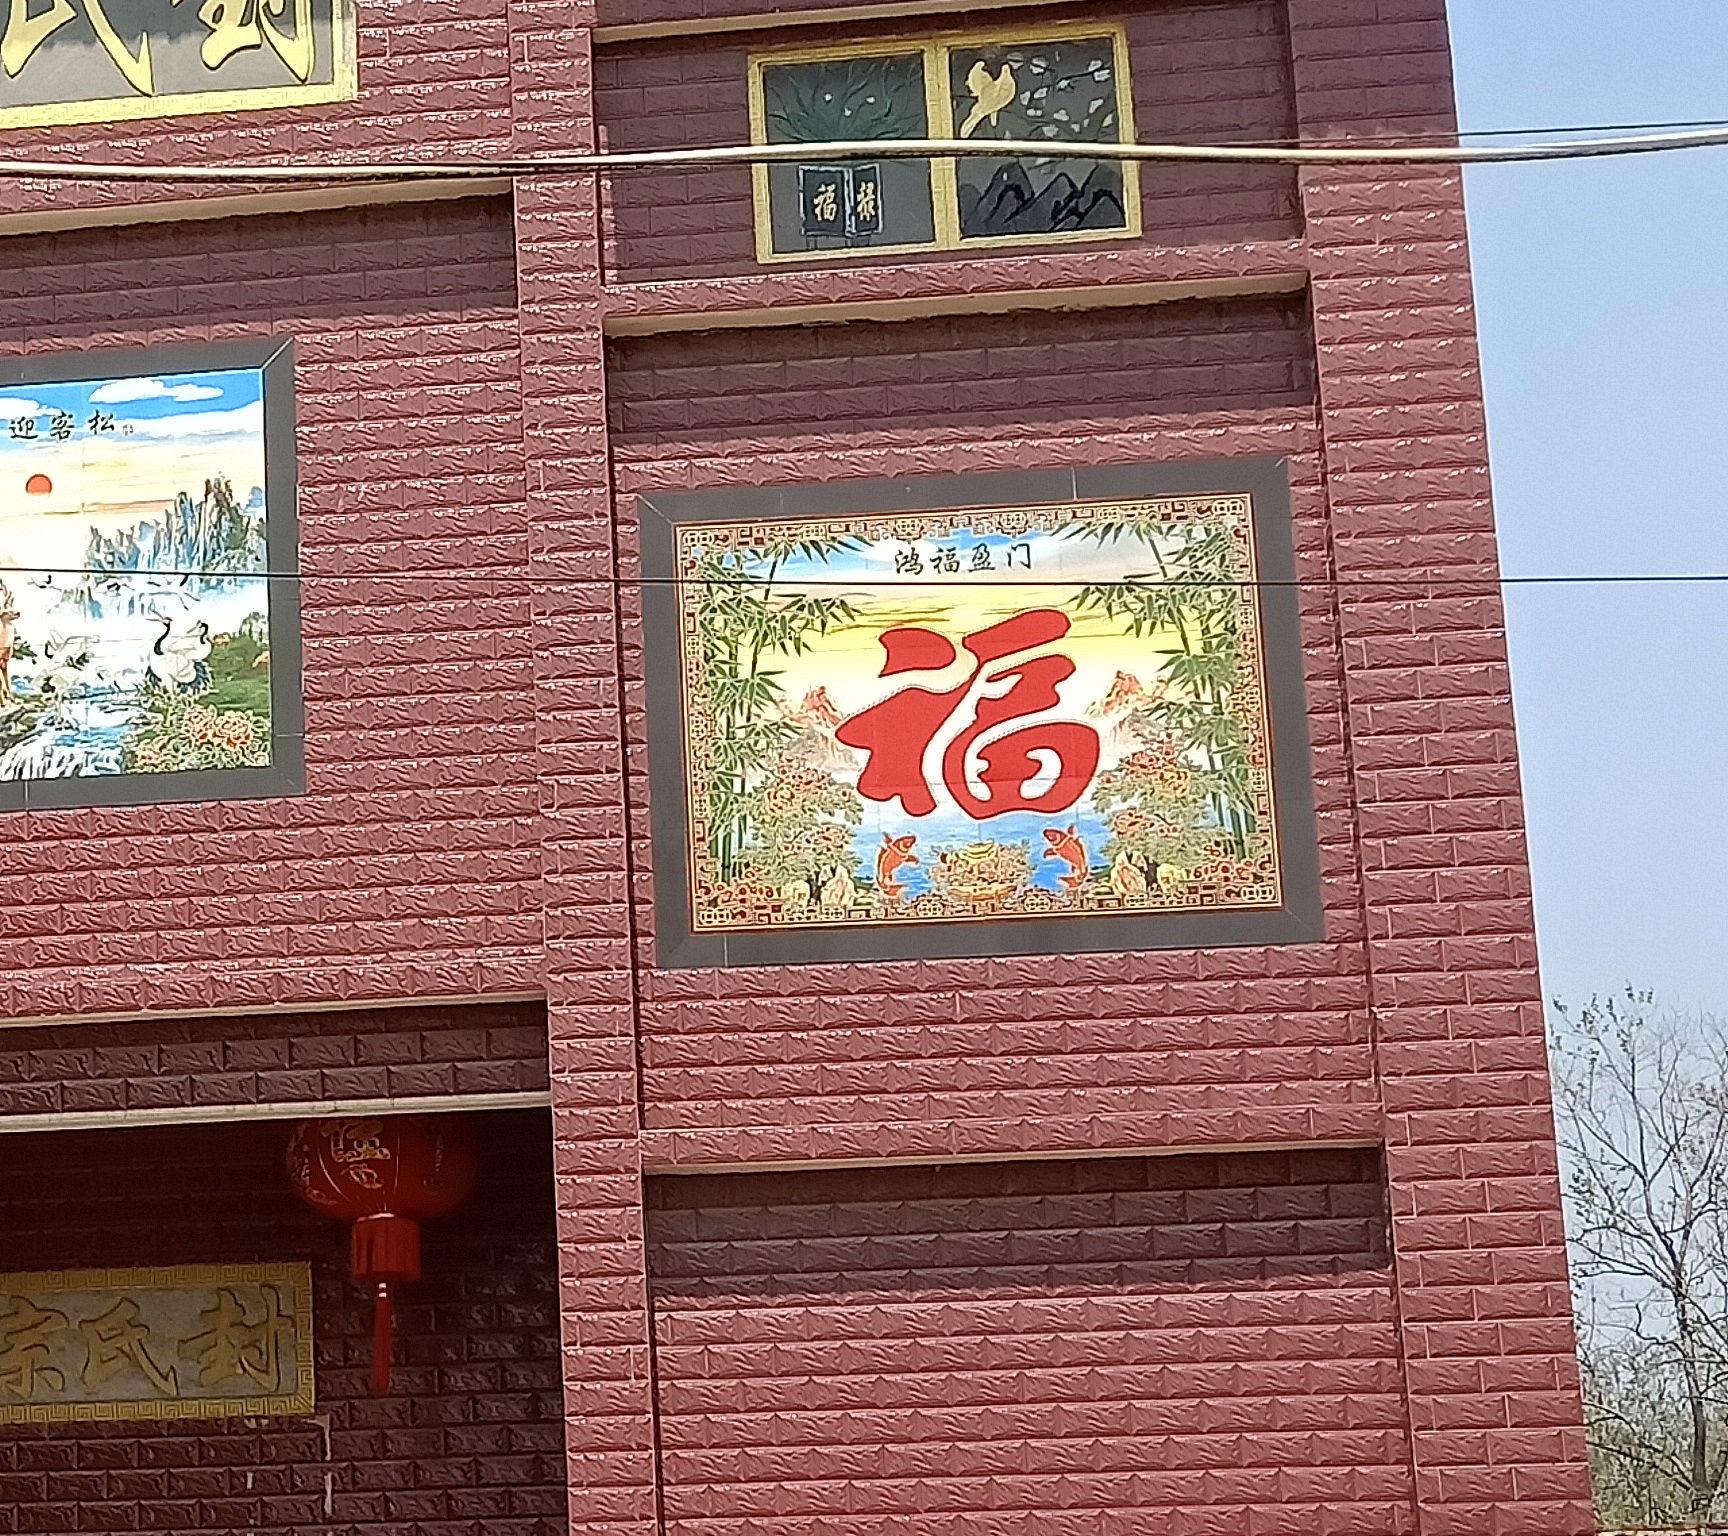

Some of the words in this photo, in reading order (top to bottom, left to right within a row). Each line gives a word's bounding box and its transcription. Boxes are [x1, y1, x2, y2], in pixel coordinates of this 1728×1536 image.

[8, 409, 116, 441] 迎客松
[894, 543, 1032, 576] 鸿福盈门
[835, 608, 1101, 821] 福
